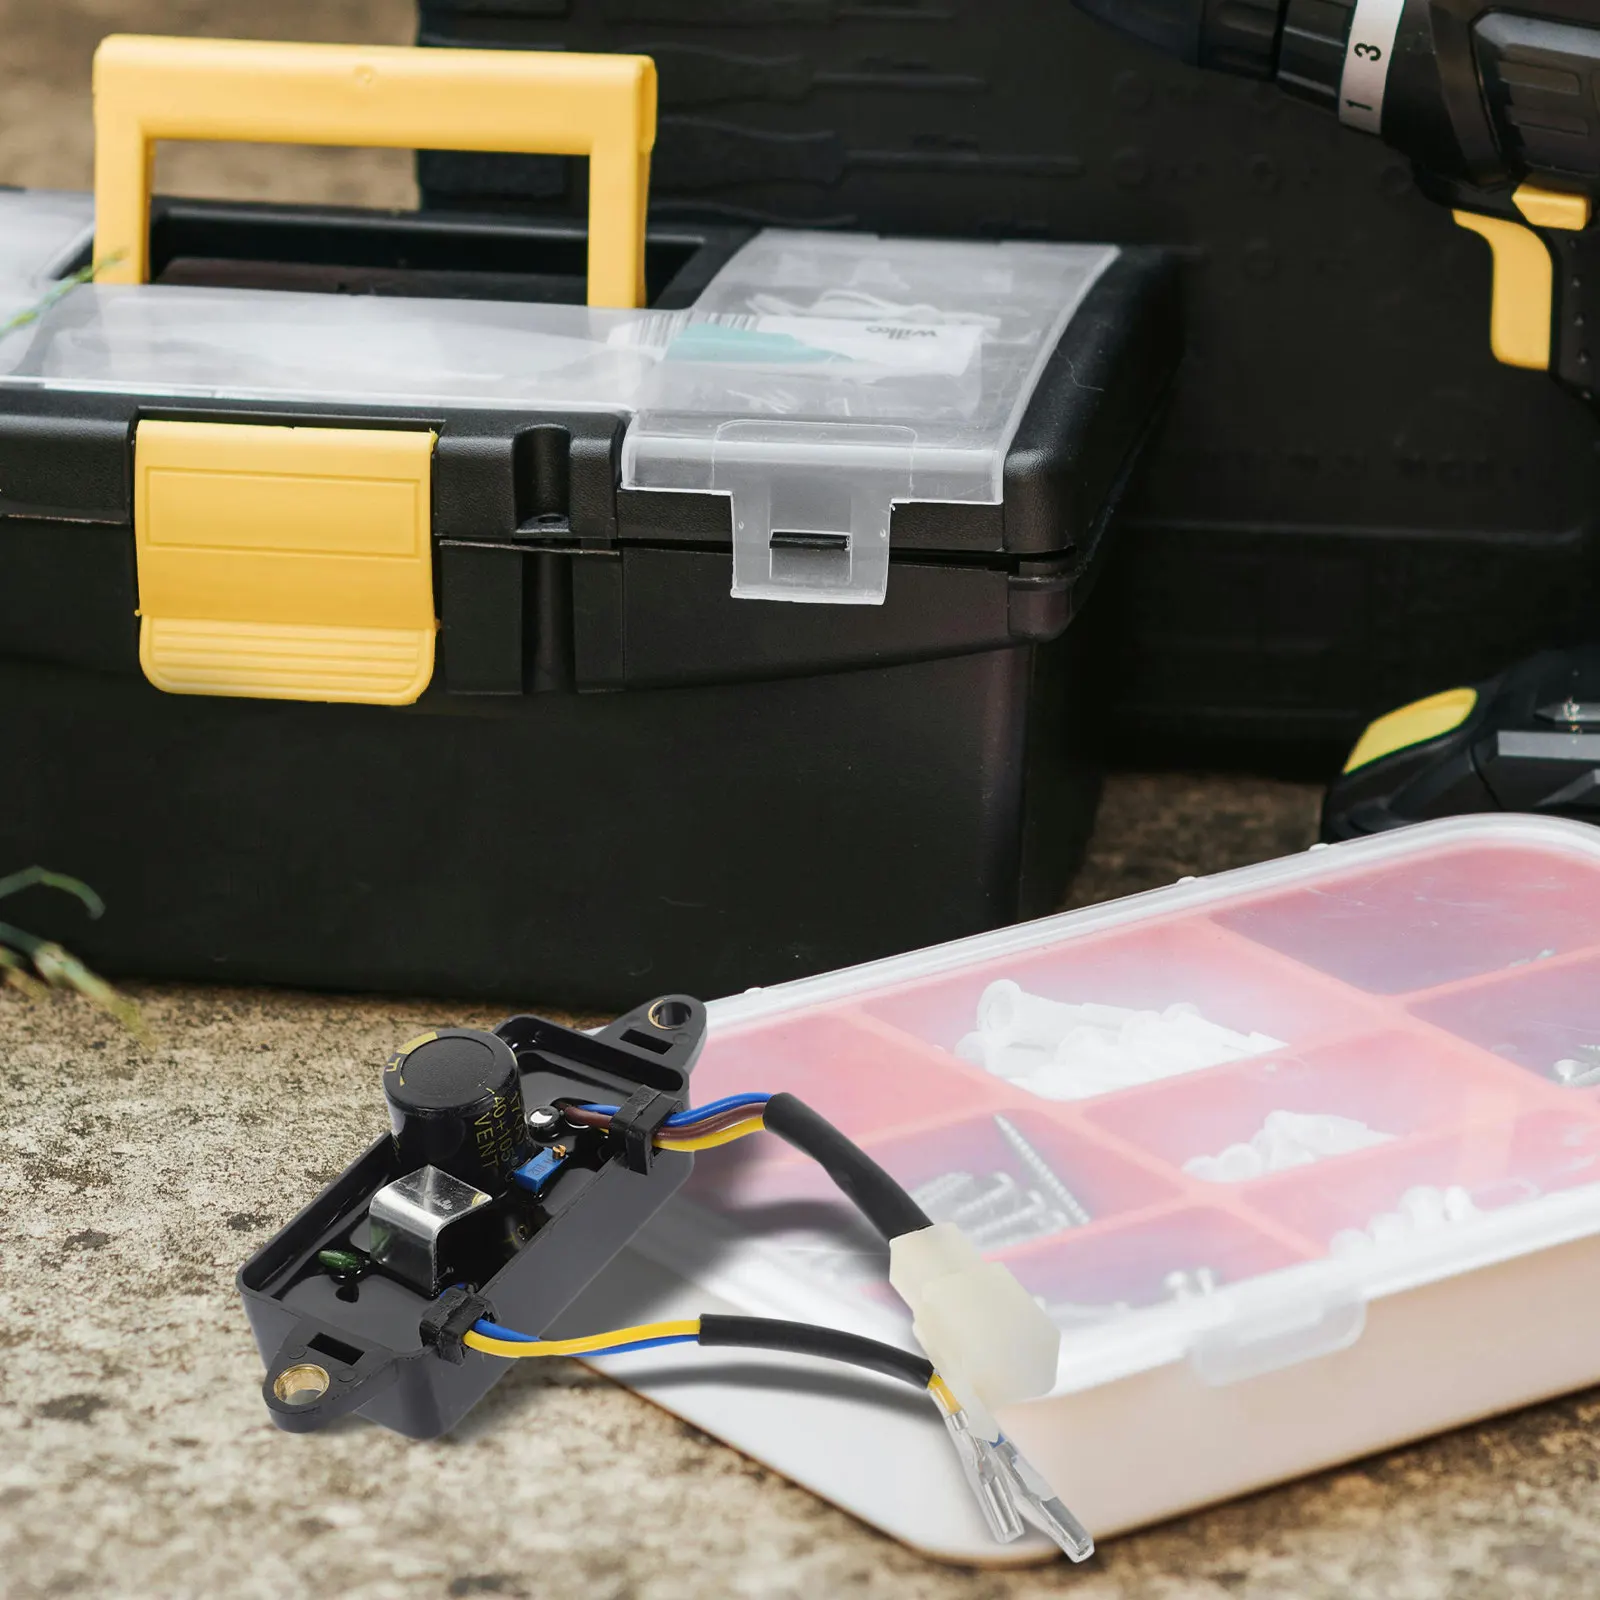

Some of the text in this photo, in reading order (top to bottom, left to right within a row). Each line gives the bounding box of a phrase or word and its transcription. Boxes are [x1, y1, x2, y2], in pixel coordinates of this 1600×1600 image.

[1345, 43, 1381, 112] 1 3
[474, 1111, 499, 1168] VENT
